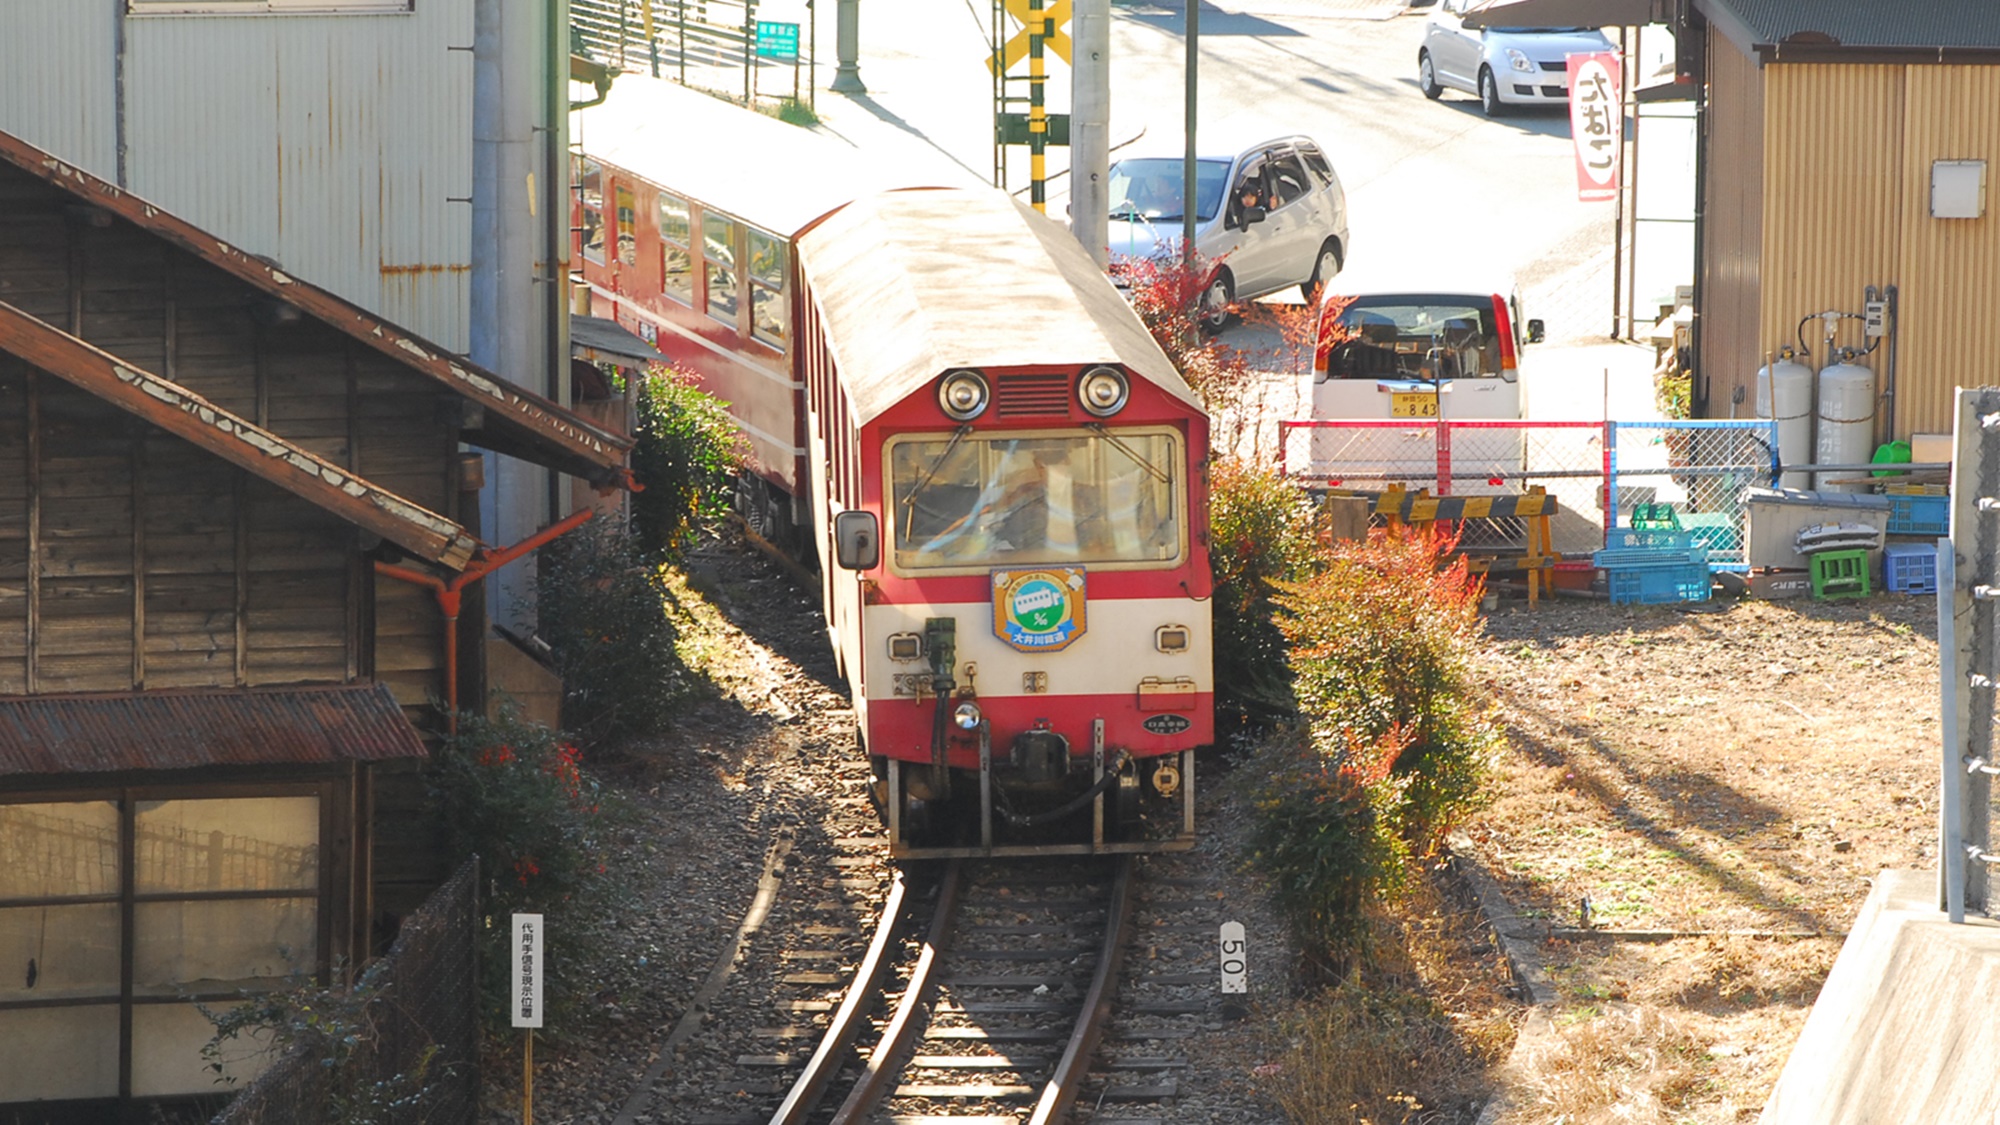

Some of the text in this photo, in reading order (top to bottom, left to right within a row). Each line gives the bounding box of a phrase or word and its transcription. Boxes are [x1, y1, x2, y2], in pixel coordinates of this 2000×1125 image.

[521, 922, 534, 1019] 代用手信号現示位置
[1222, 940, 1245, 974] 50
